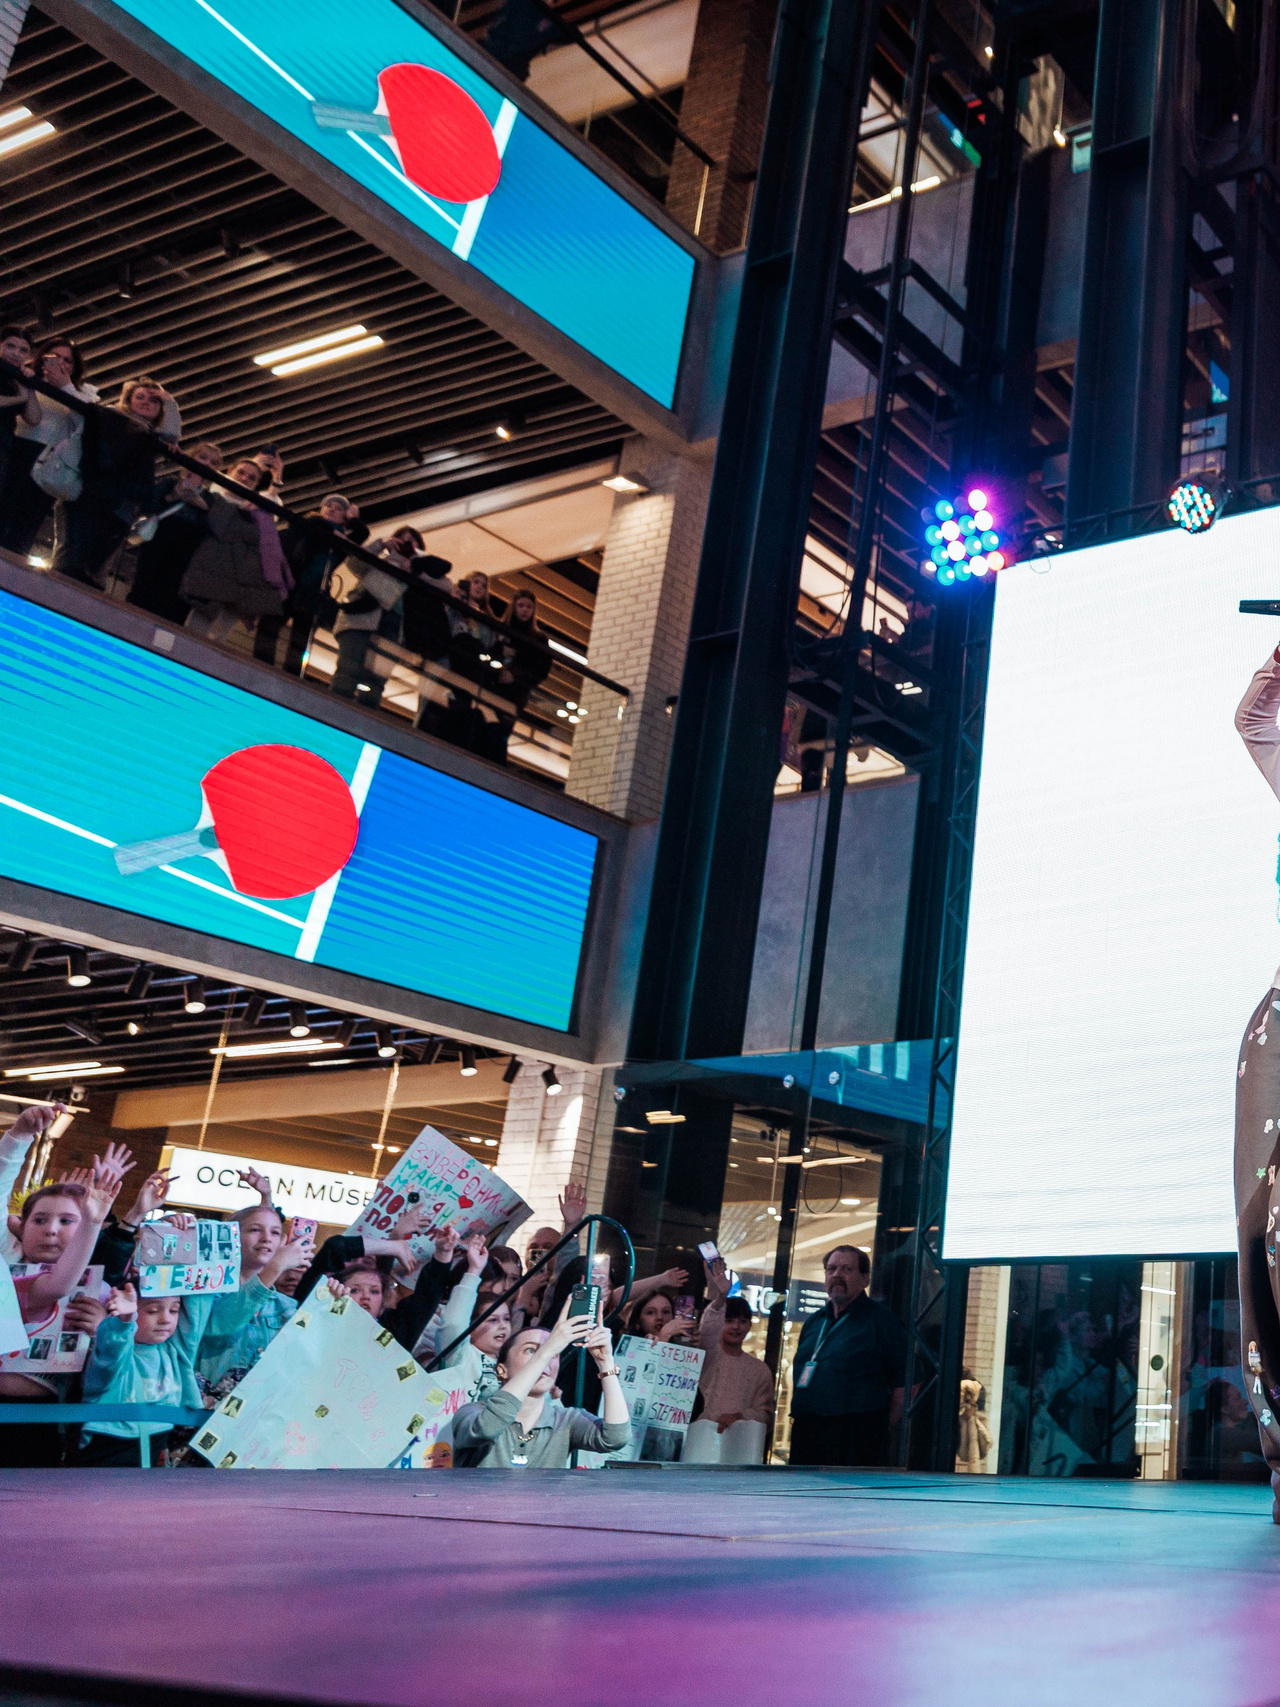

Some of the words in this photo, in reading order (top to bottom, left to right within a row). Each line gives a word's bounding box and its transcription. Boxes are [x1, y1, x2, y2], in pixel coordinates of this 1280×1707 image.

[197, 1166, 294, 1196] OCEN
[661, 1346, 699, 1364] STESHA
[658, 1373, 698, 1391] STESHOK
